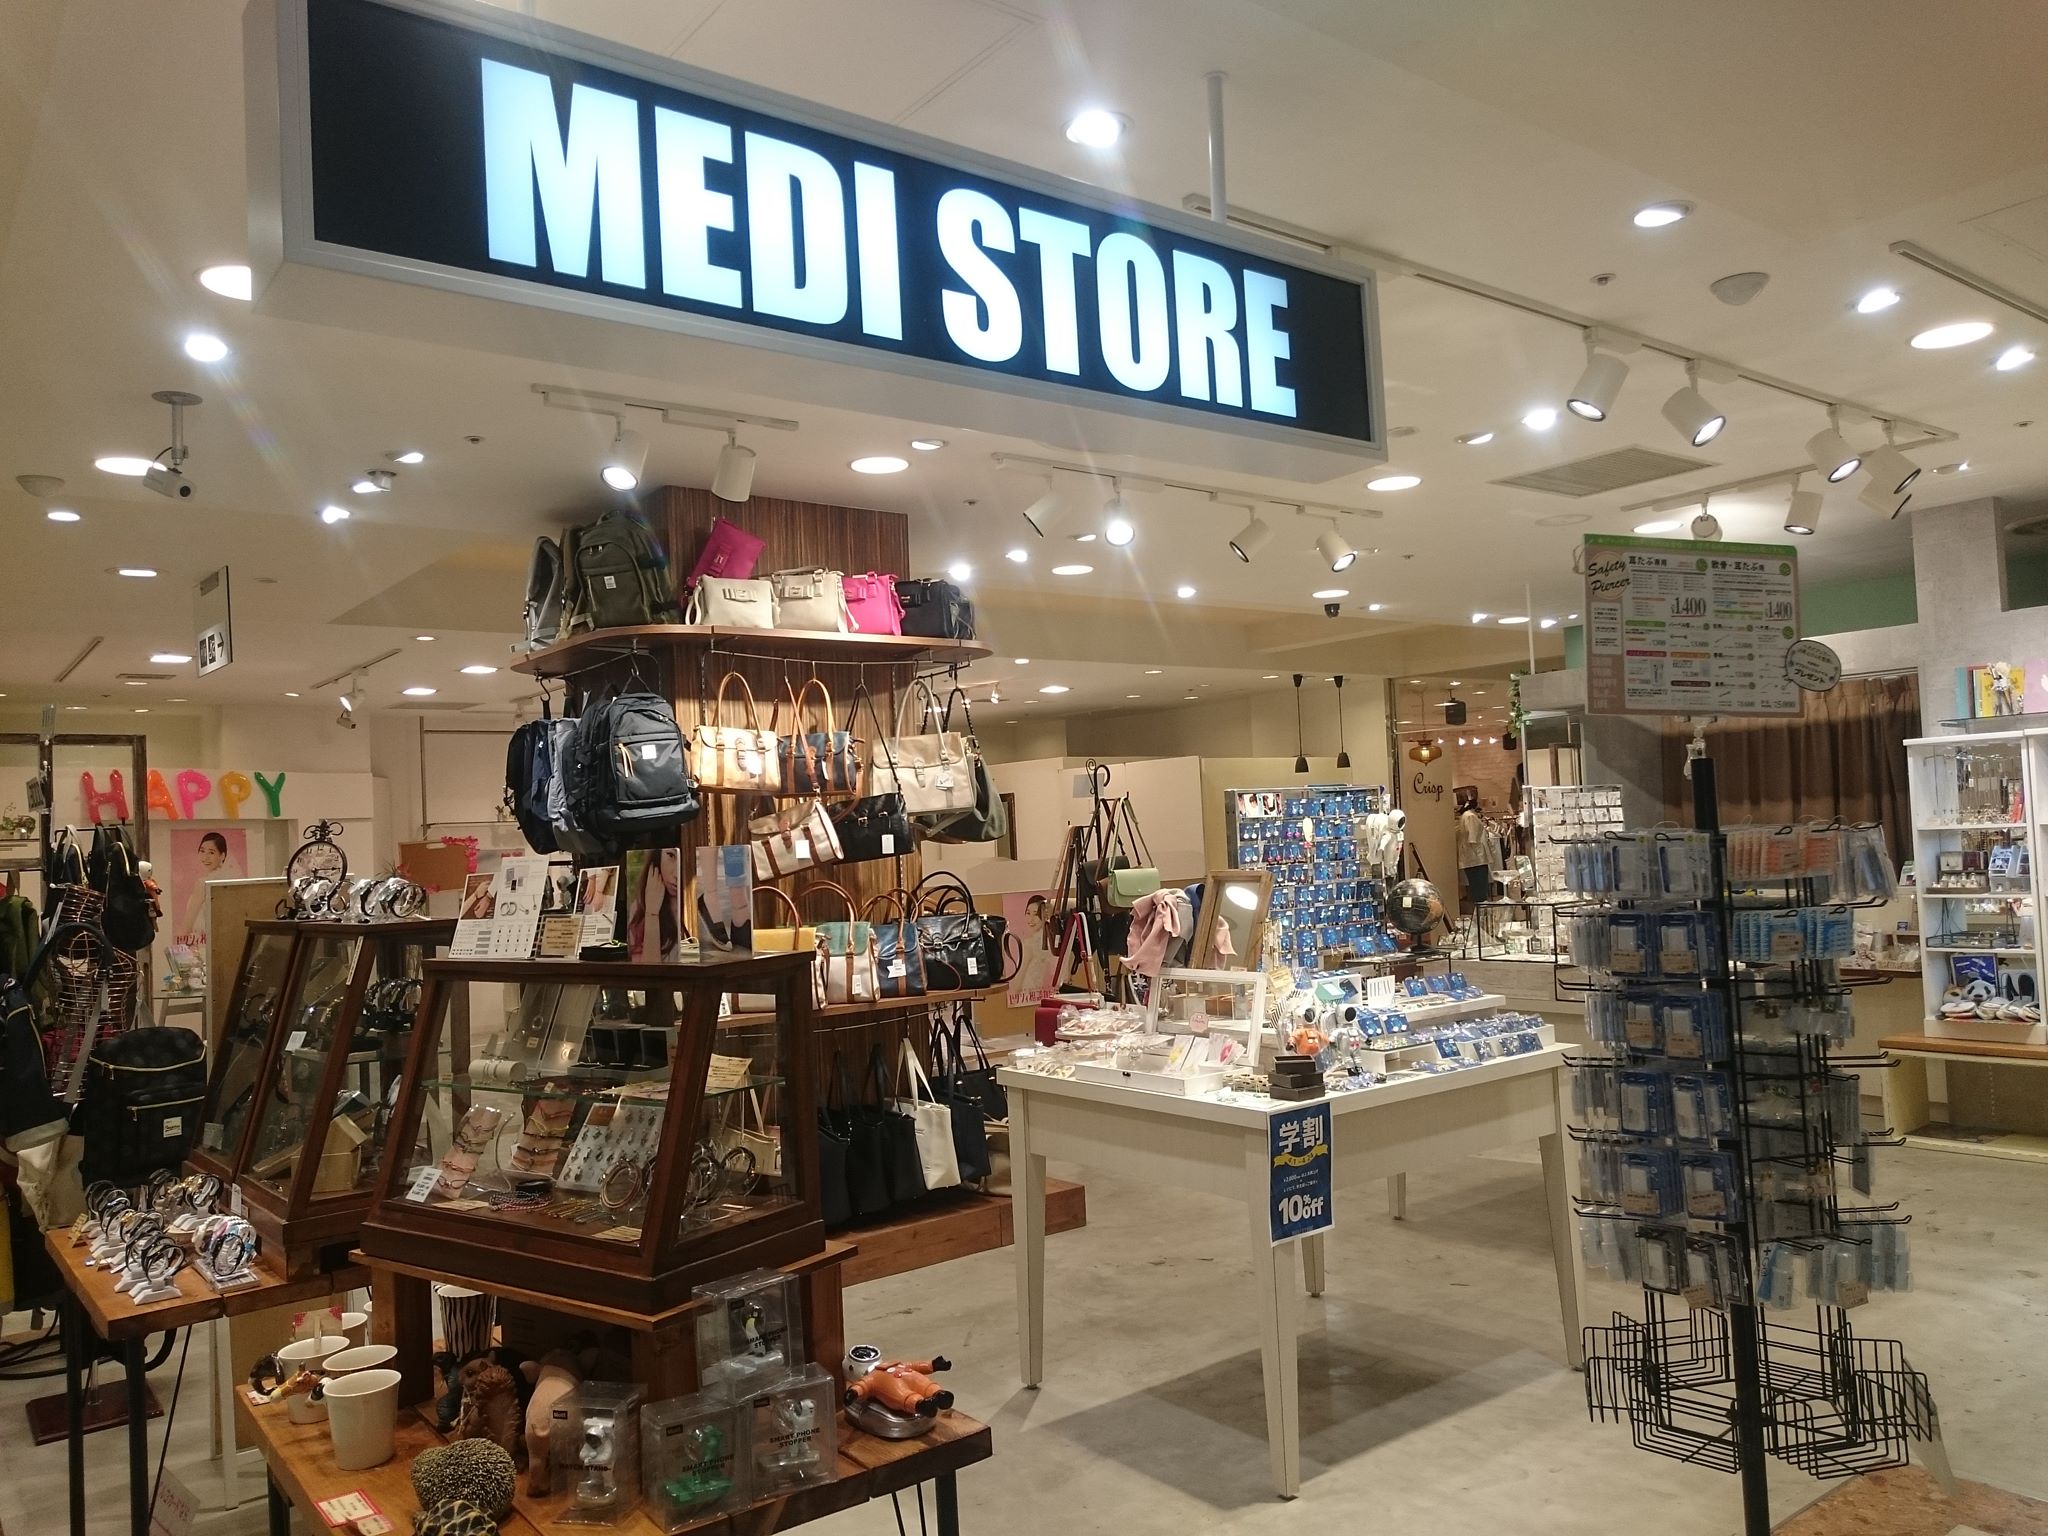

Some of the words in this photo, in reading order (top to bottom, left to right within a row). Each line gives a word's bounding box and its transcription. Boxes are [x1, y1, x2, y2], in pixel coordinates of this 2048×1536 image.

[481, 57, 903, 340] MEDI
[936, 188, 1298, 418] STORE
[1588, 559, 1627, 577] Safety
[1591, 578, 1632, 595] Piercer
[1794, 668, 1826, 684] プレゼント
[80, 769, 286, 824] HAPPY
[1413, 772, 1445, 802] Crisp
[1279, 1115, 1324, 1153] 学割
[770, 1433, 796, 1443] SMART
[796, 1427, 820, 1438] PHONE
